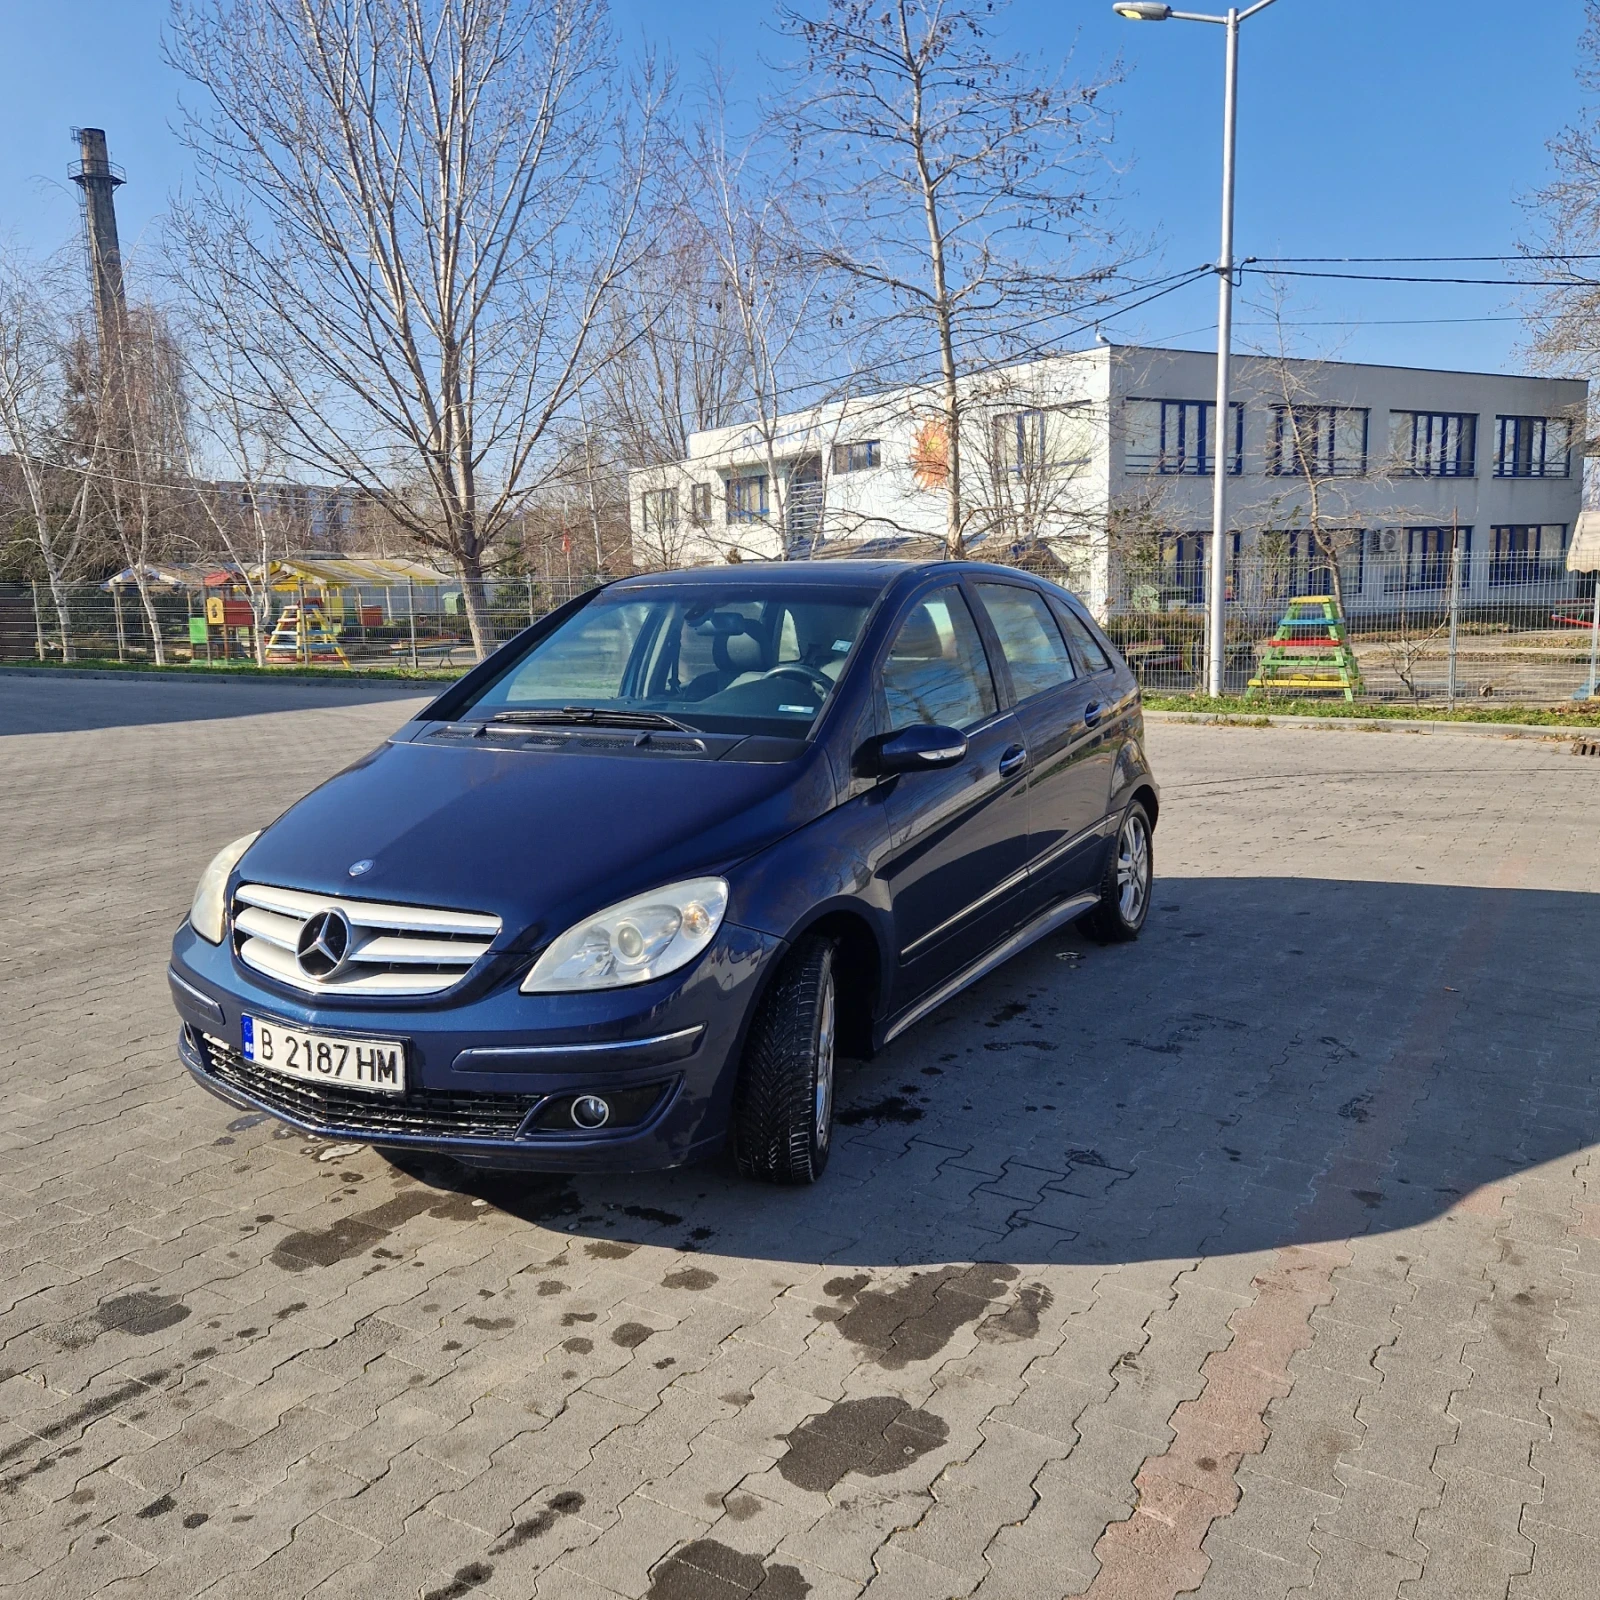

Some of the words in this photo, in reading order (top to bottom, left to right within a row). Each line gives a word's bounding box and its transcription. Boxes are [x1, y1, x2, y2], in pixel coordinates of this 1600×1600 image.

[261, 1027, 274, 1061] B
[285, 1036, 350, 1077] 2187
[356, 1046, 398, 1084] HM
